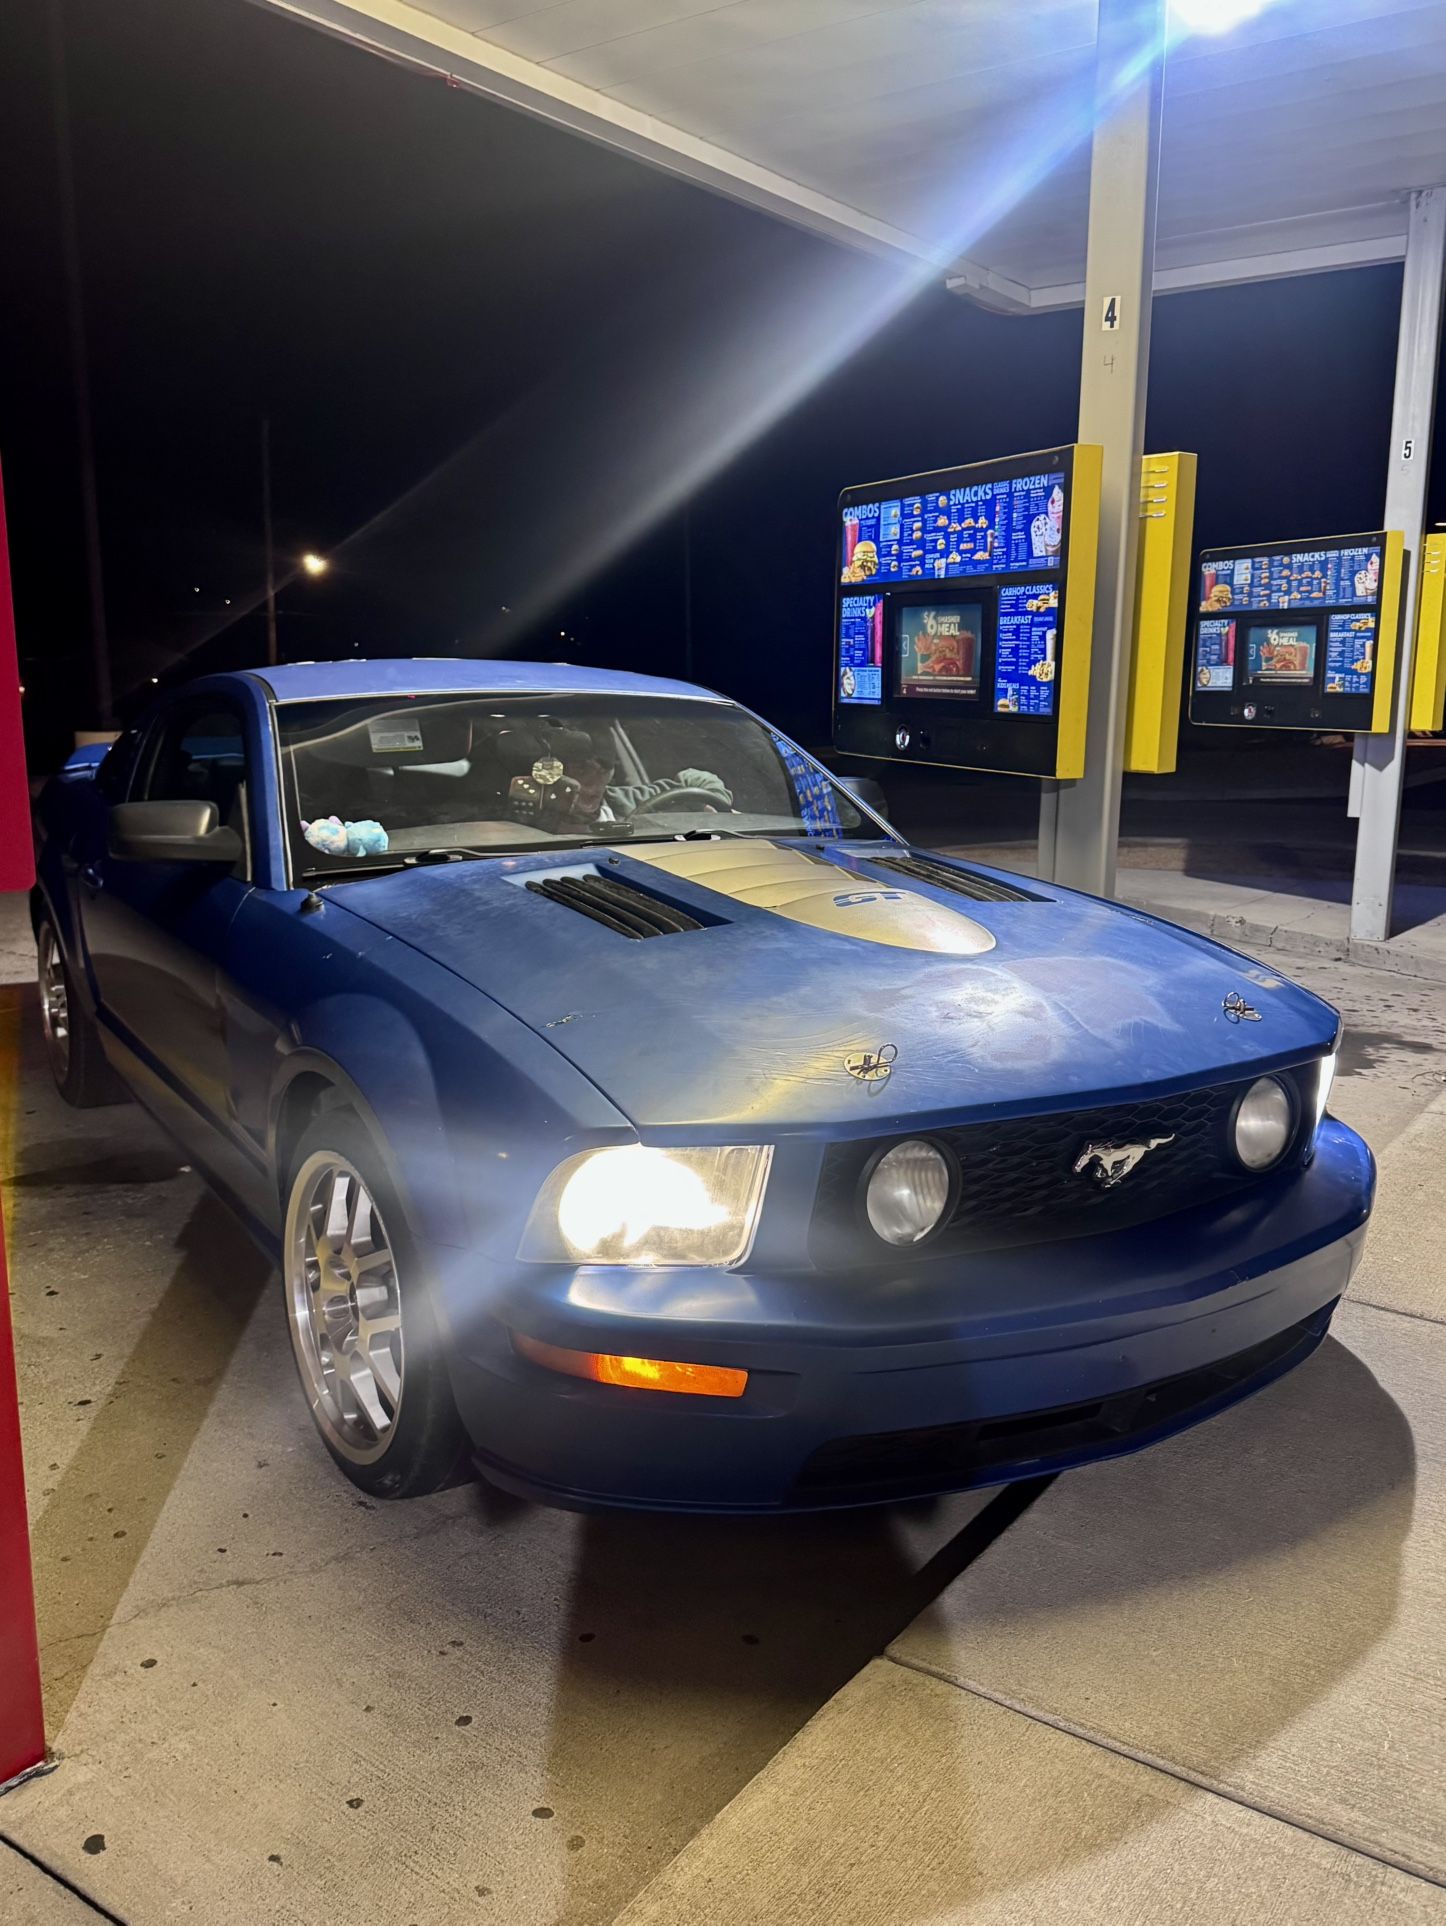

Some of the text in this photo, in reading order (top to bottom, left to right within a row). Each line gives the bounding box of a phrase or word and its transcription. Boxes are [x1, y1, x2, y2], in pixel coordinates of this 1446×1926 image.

[1104, 297, 1117, 329] 4
[1103, 354, 1114, 374] 4
[1403, 440, 1412, 459] 5
[1012, 474, 1048, 492] FROZEN
[949, 483, 992, 505] SNACKS
[842, 502, 879, 522] COMBOS
[1291, 551, 1326, 563] SNACKS
[1340, 547, 1369, 557] FROZEN
[1201, 560, 1234, 571] COMBOS
[1001, 584, 1053, 596] CARHOP CLASSICS
[842, 596, 875, 607] SPECIALTY
[842, 607, 866, 617] DRINKS
[923, 611, 937, 636] $6
[999, 615, 1032, 625] BREAKFAST
[1200, 619, 1228, 628] SPECIALTY
[937, 623, 960, 636] MEAL
[1279, 637, 1297, 645] MEAL
